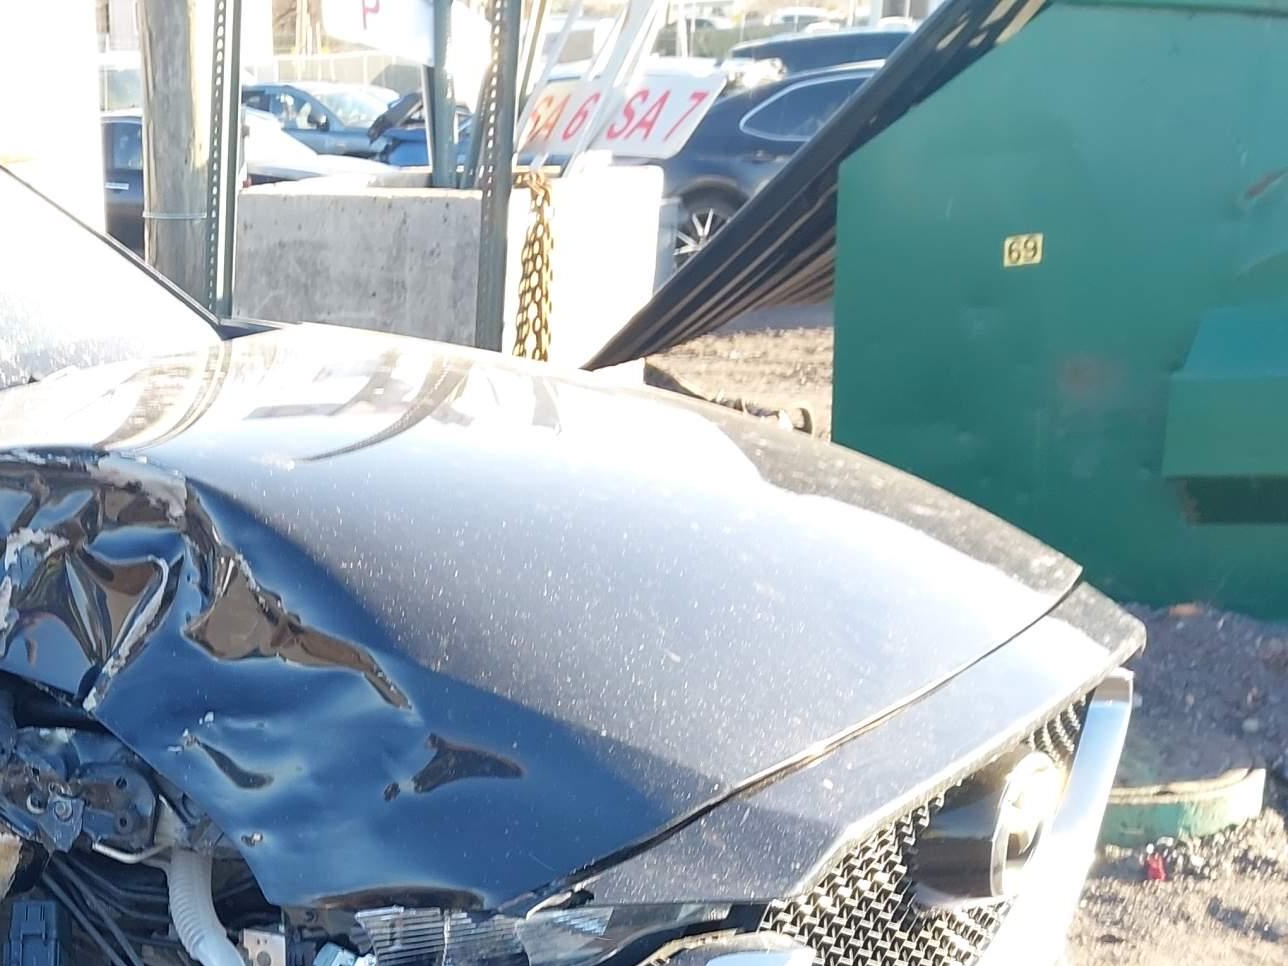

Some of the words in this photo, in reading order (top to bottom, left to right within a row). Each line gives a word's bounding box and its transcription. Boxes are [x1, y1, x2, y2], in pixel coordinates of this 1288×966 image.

[562, 91, 601, 141] 6
[606, 88, 670, 141] SA
[663, 91, 710, 142] 7
[1007, 236, 1038, 264] 69
